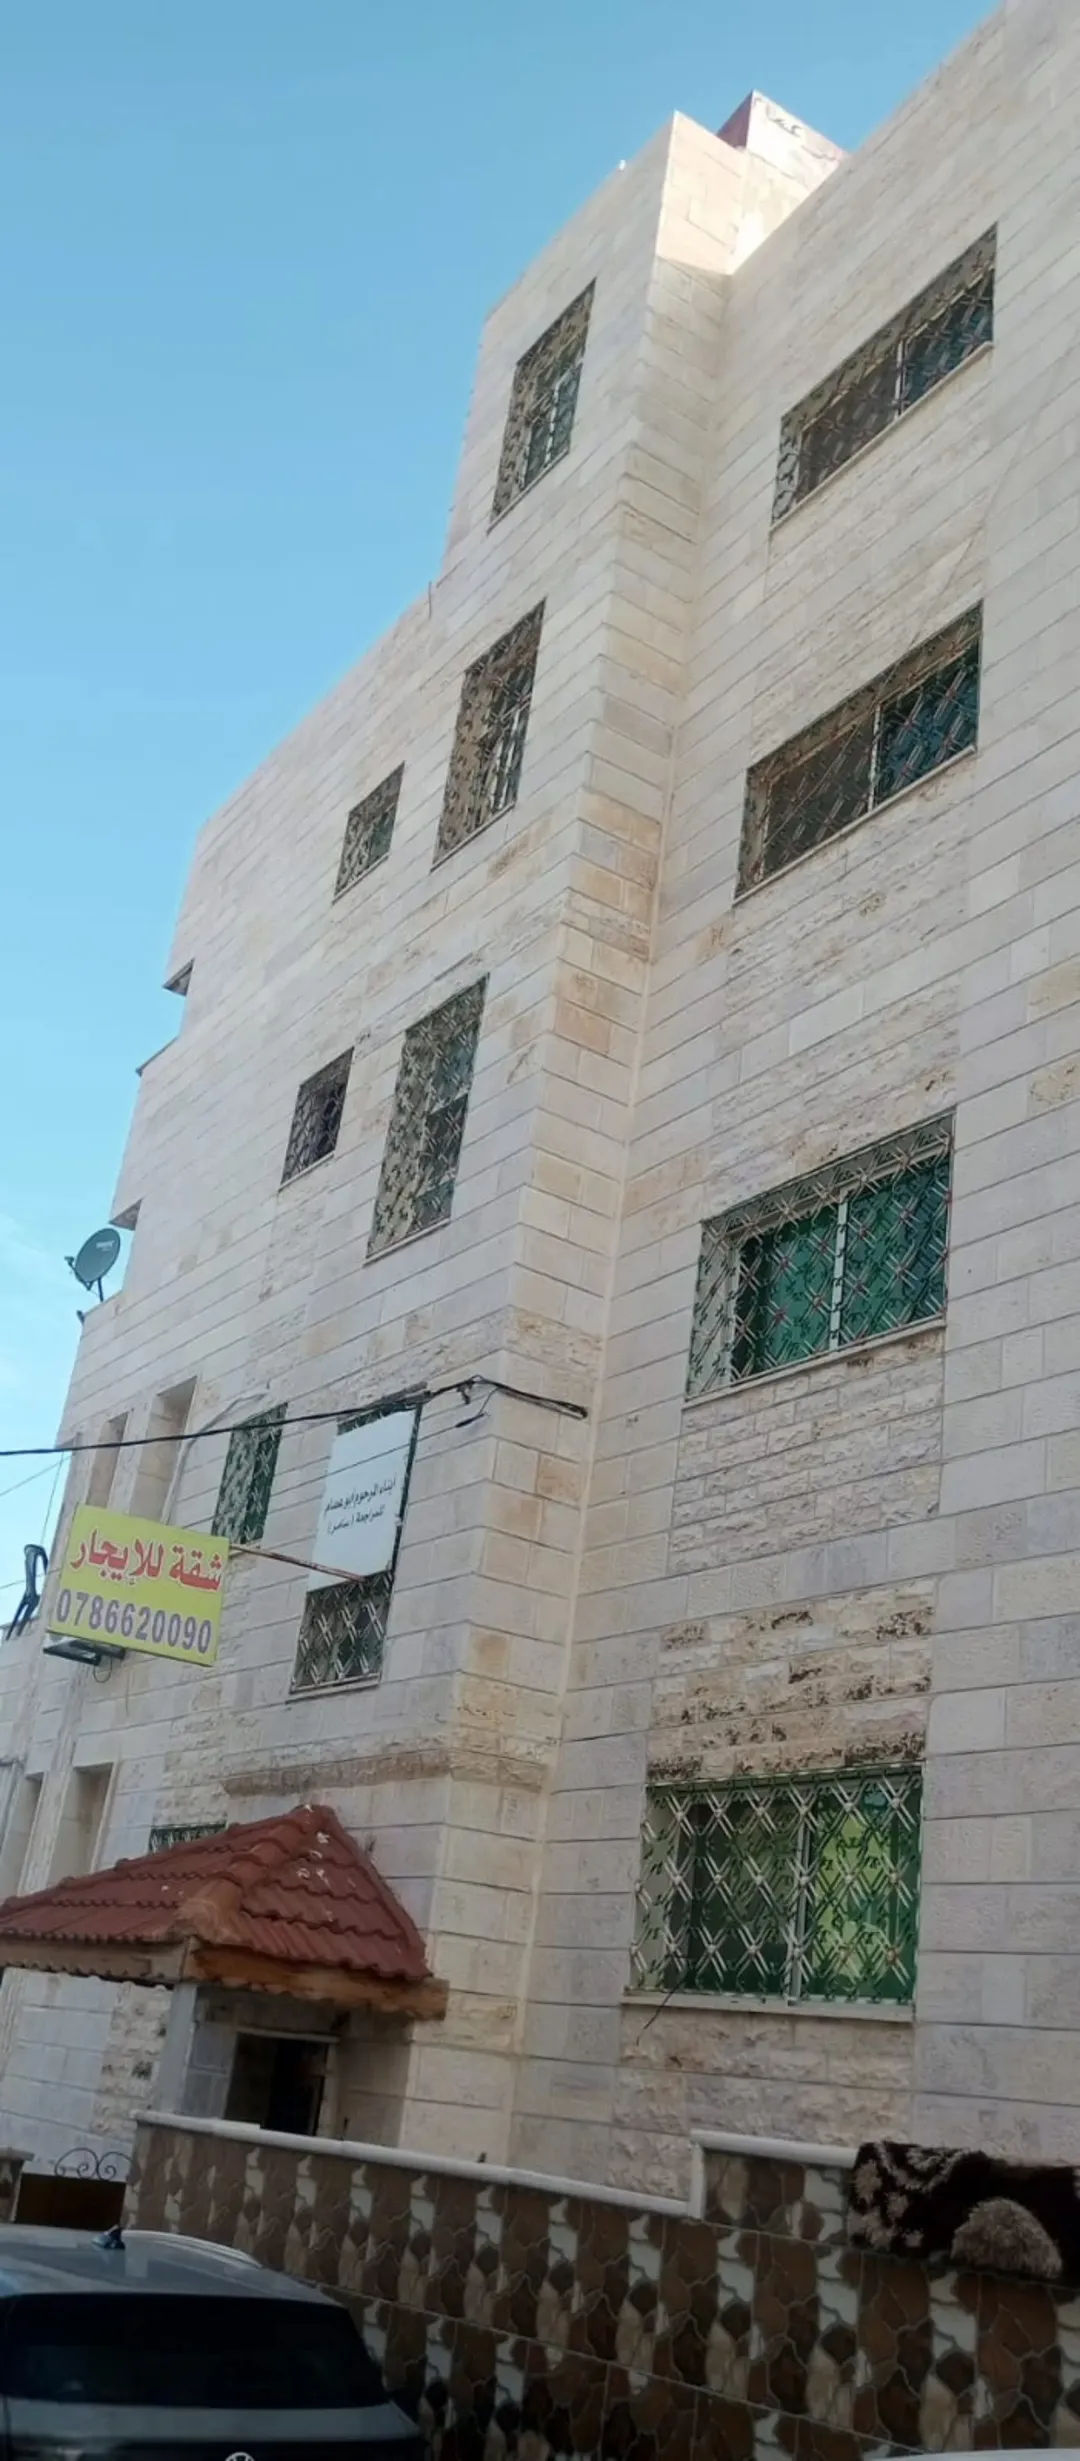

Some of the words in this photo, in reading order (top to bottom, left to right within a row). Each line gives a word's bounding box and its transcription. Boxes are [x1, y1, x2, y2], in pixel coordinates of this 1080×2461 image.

[70, 1528, 164, 1586] للإيجار
[169, 1545, 222, 1590] شقة
[56, 1588, 212, 1654] 0786620090
